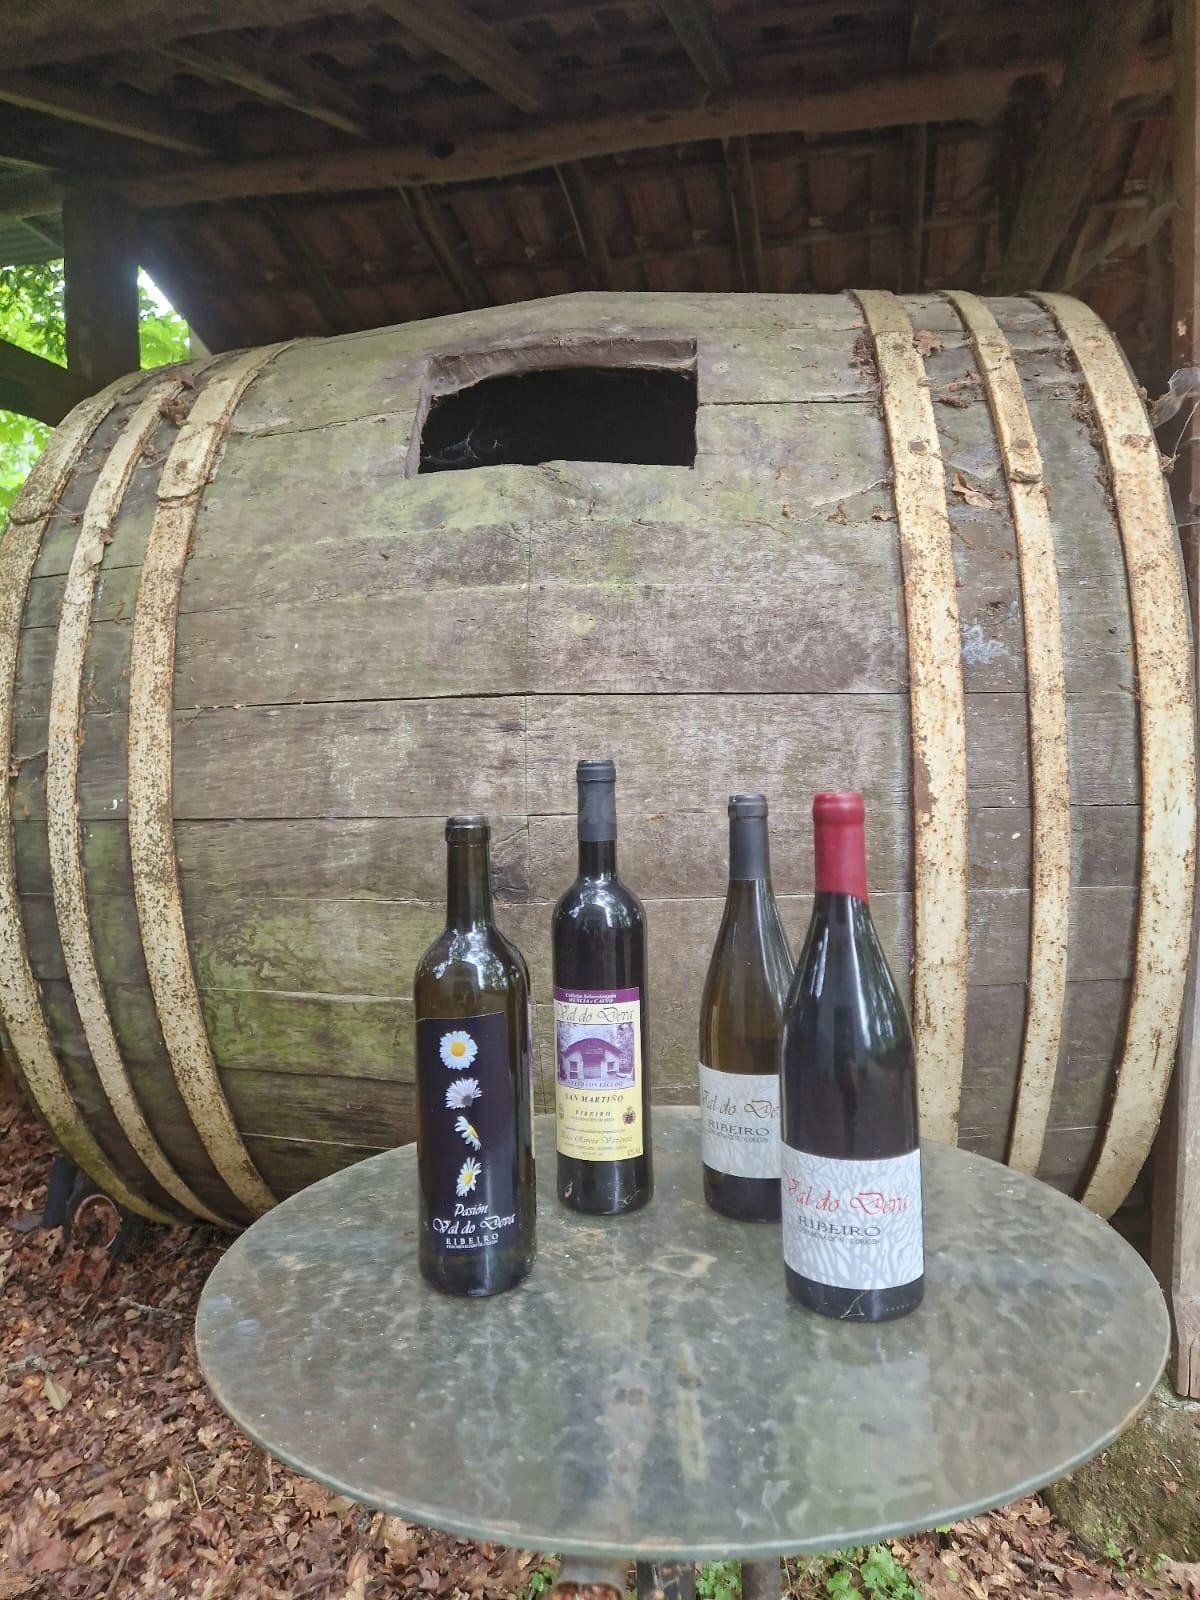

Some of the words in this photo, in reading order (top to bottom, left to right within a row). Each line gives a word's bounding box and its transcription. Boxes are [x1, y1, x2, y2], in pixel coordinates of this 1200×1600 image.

[578, 1008, 592, 1022] do
[581, 1094, 624, 1103] MARTIÑO
[719, 1098, 736, 1115] do
[708, 1120, 770, 1136] RIBEIRO
[784, 1168, 813, 1206] Val
[816, 1190, 840, 1212] do
[454, 1203, 489, 1217] Pasión
[433, 1218, 460, 1234] Val
[461, 1220, 476, 1234] do
[799, 1216, 881, 1236] RIBEIRO
[446, 1233, 499, 1245] RIBEIRO
